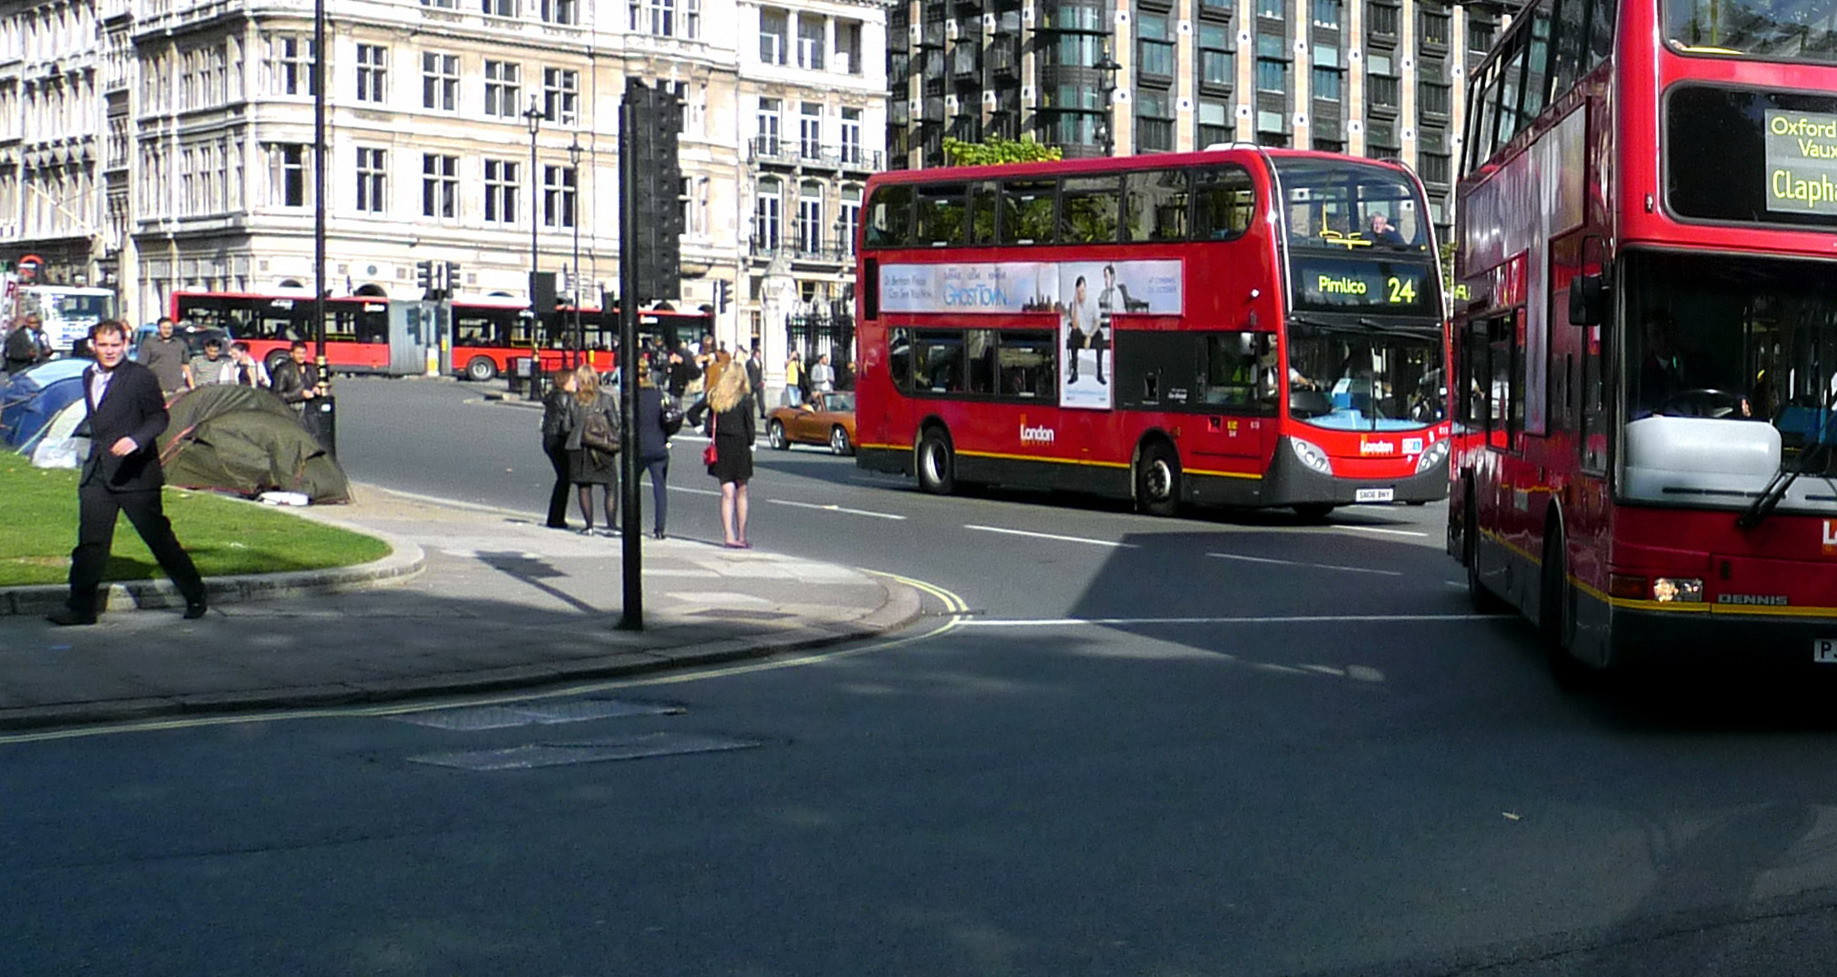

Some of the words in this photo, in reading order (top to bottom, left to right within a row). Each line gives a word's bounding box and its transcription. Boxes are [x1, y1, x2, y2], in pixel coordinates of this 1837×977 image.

[1771, 116, 1837, 138] Oxford
[1318, 275, 1367, 294] Pimlico
[1388, 277, 1416, 304] 24
[1020, 424, 1054, 442] London
[1360, 439, 1394, 454] London
[1717, 593, 1788, 606] DENNIS
